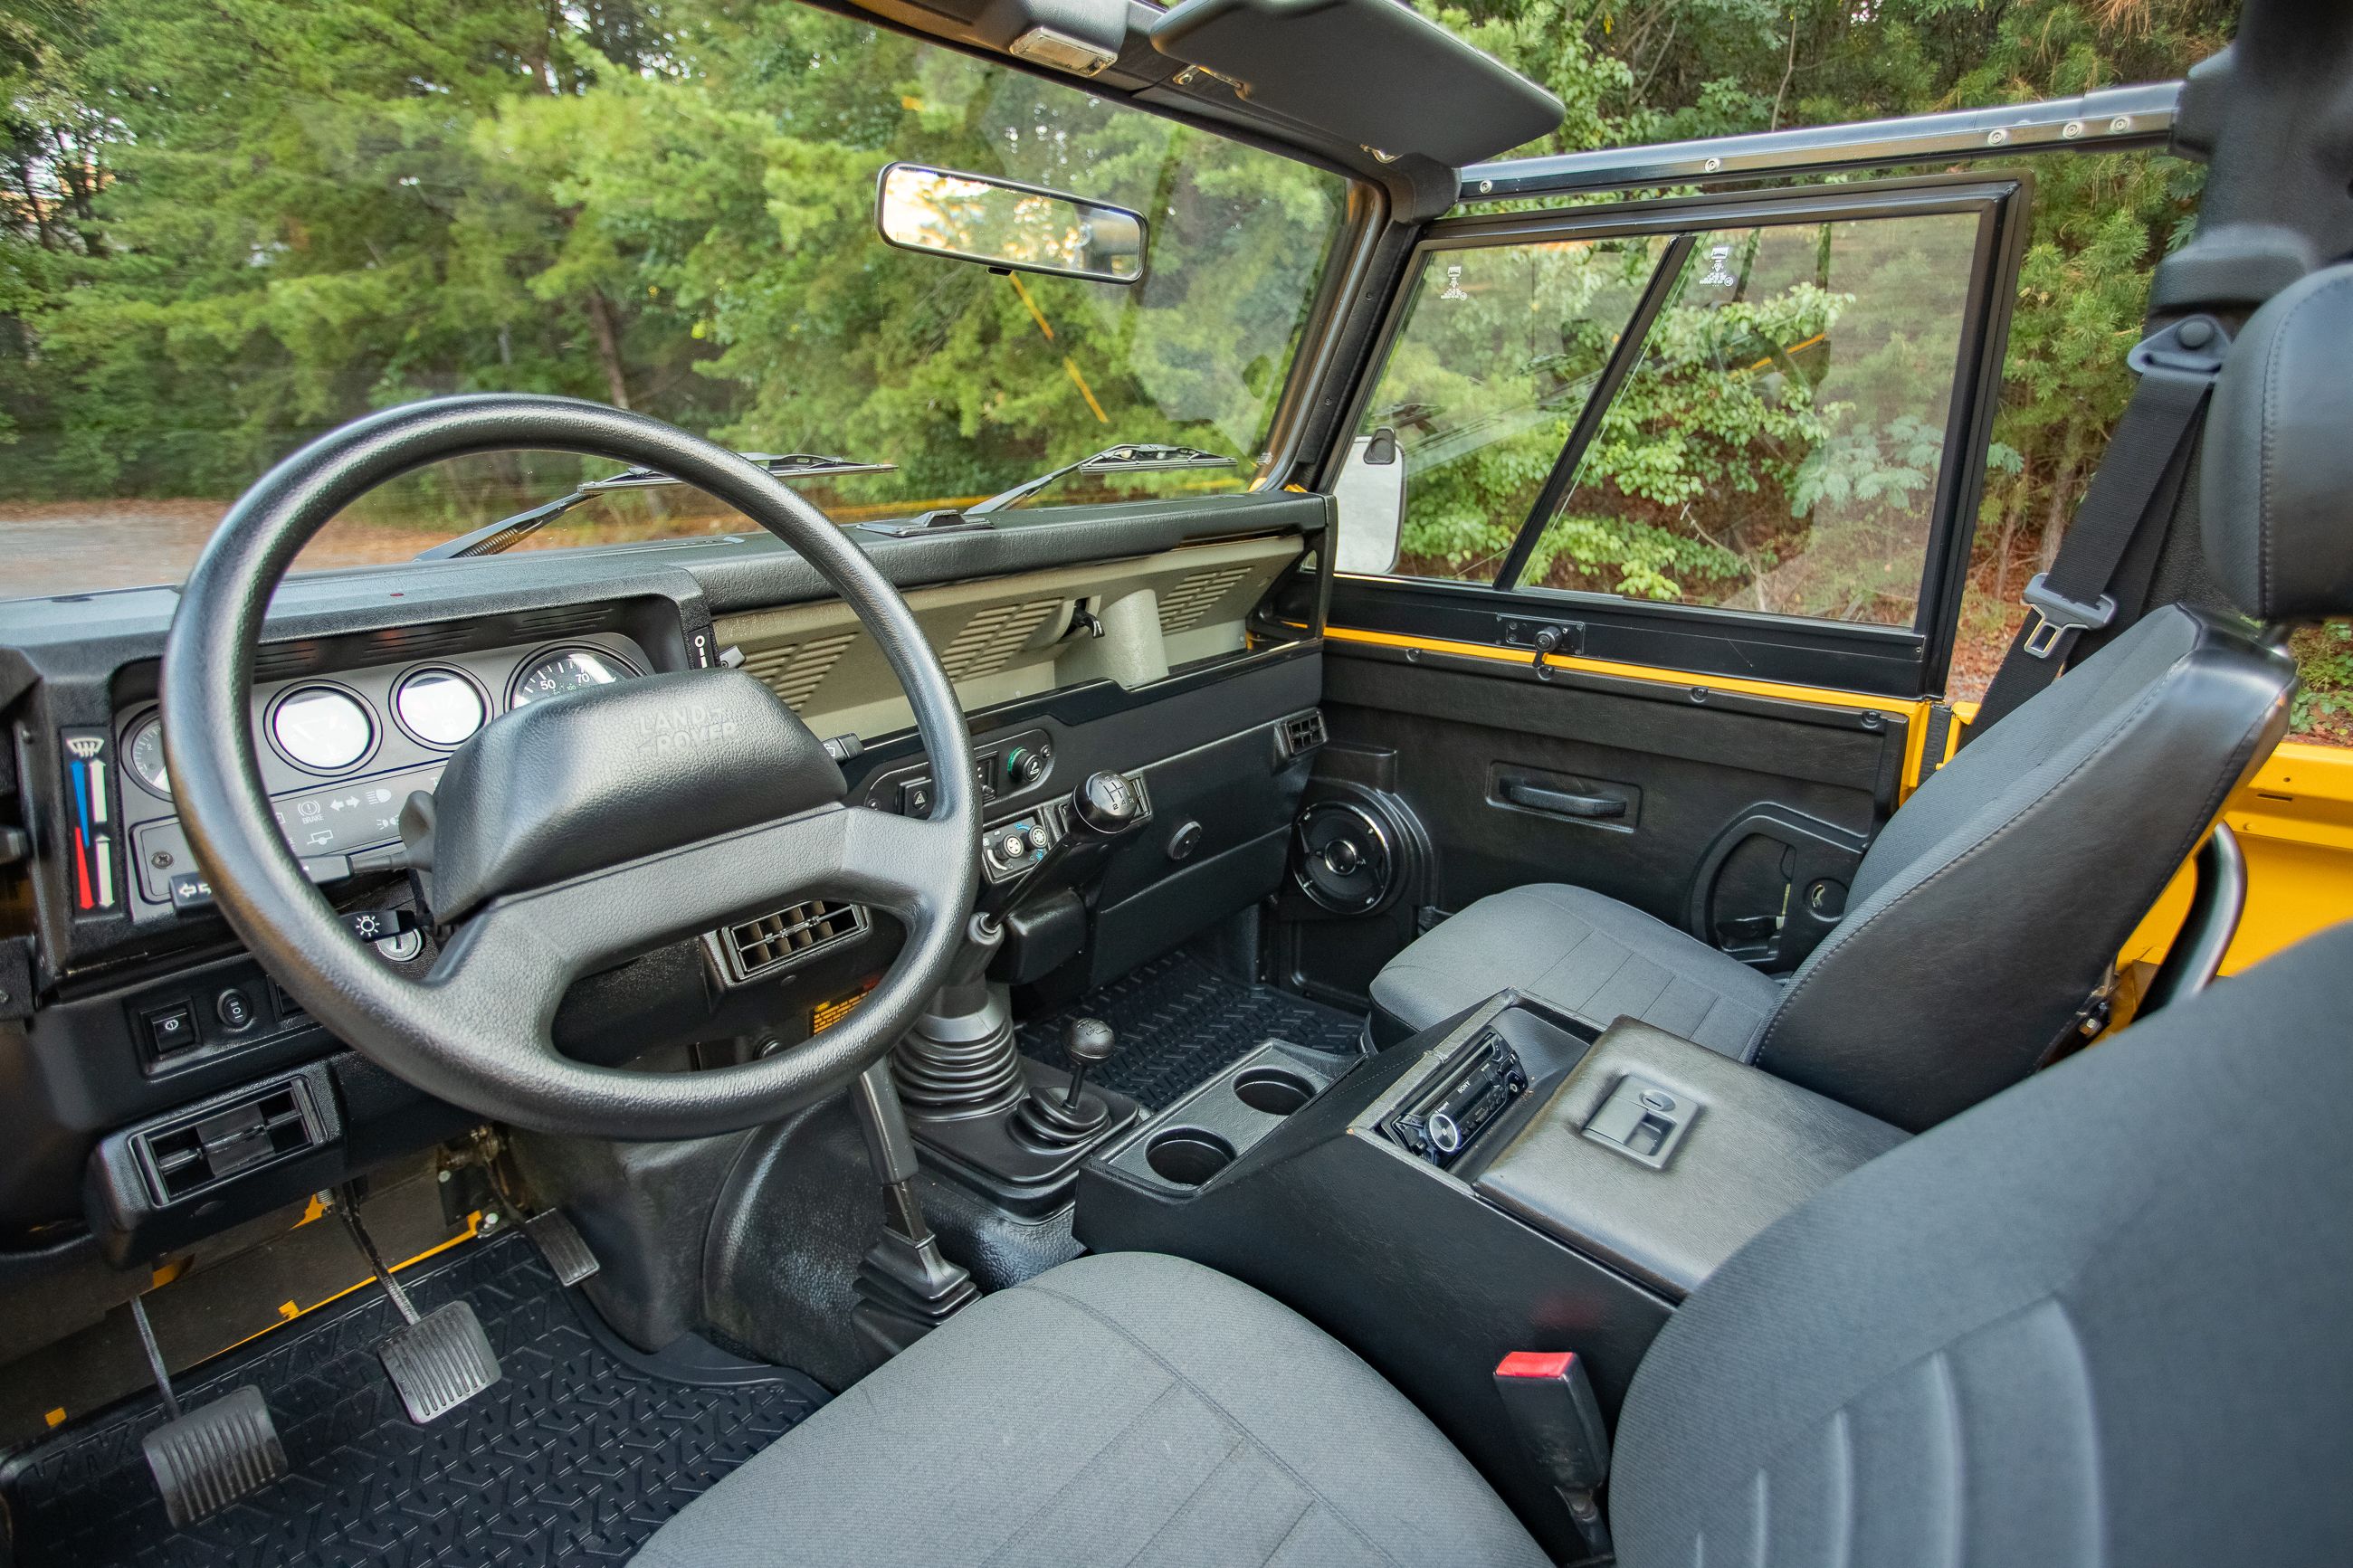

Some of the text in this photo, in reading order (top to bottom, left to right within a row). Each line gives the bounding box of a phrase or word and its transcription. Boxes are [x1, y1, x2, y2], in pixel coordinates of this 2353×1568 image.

[540, 679, 556, 689] 50
[576, 673, 590, 684] 70
[639, 706, 707, 736] LAND
[655, 721, 737, 755] ROVER
[302, 814, 324, 824] BRAKE
[1457, 1079, 1471, 1094] SONY
